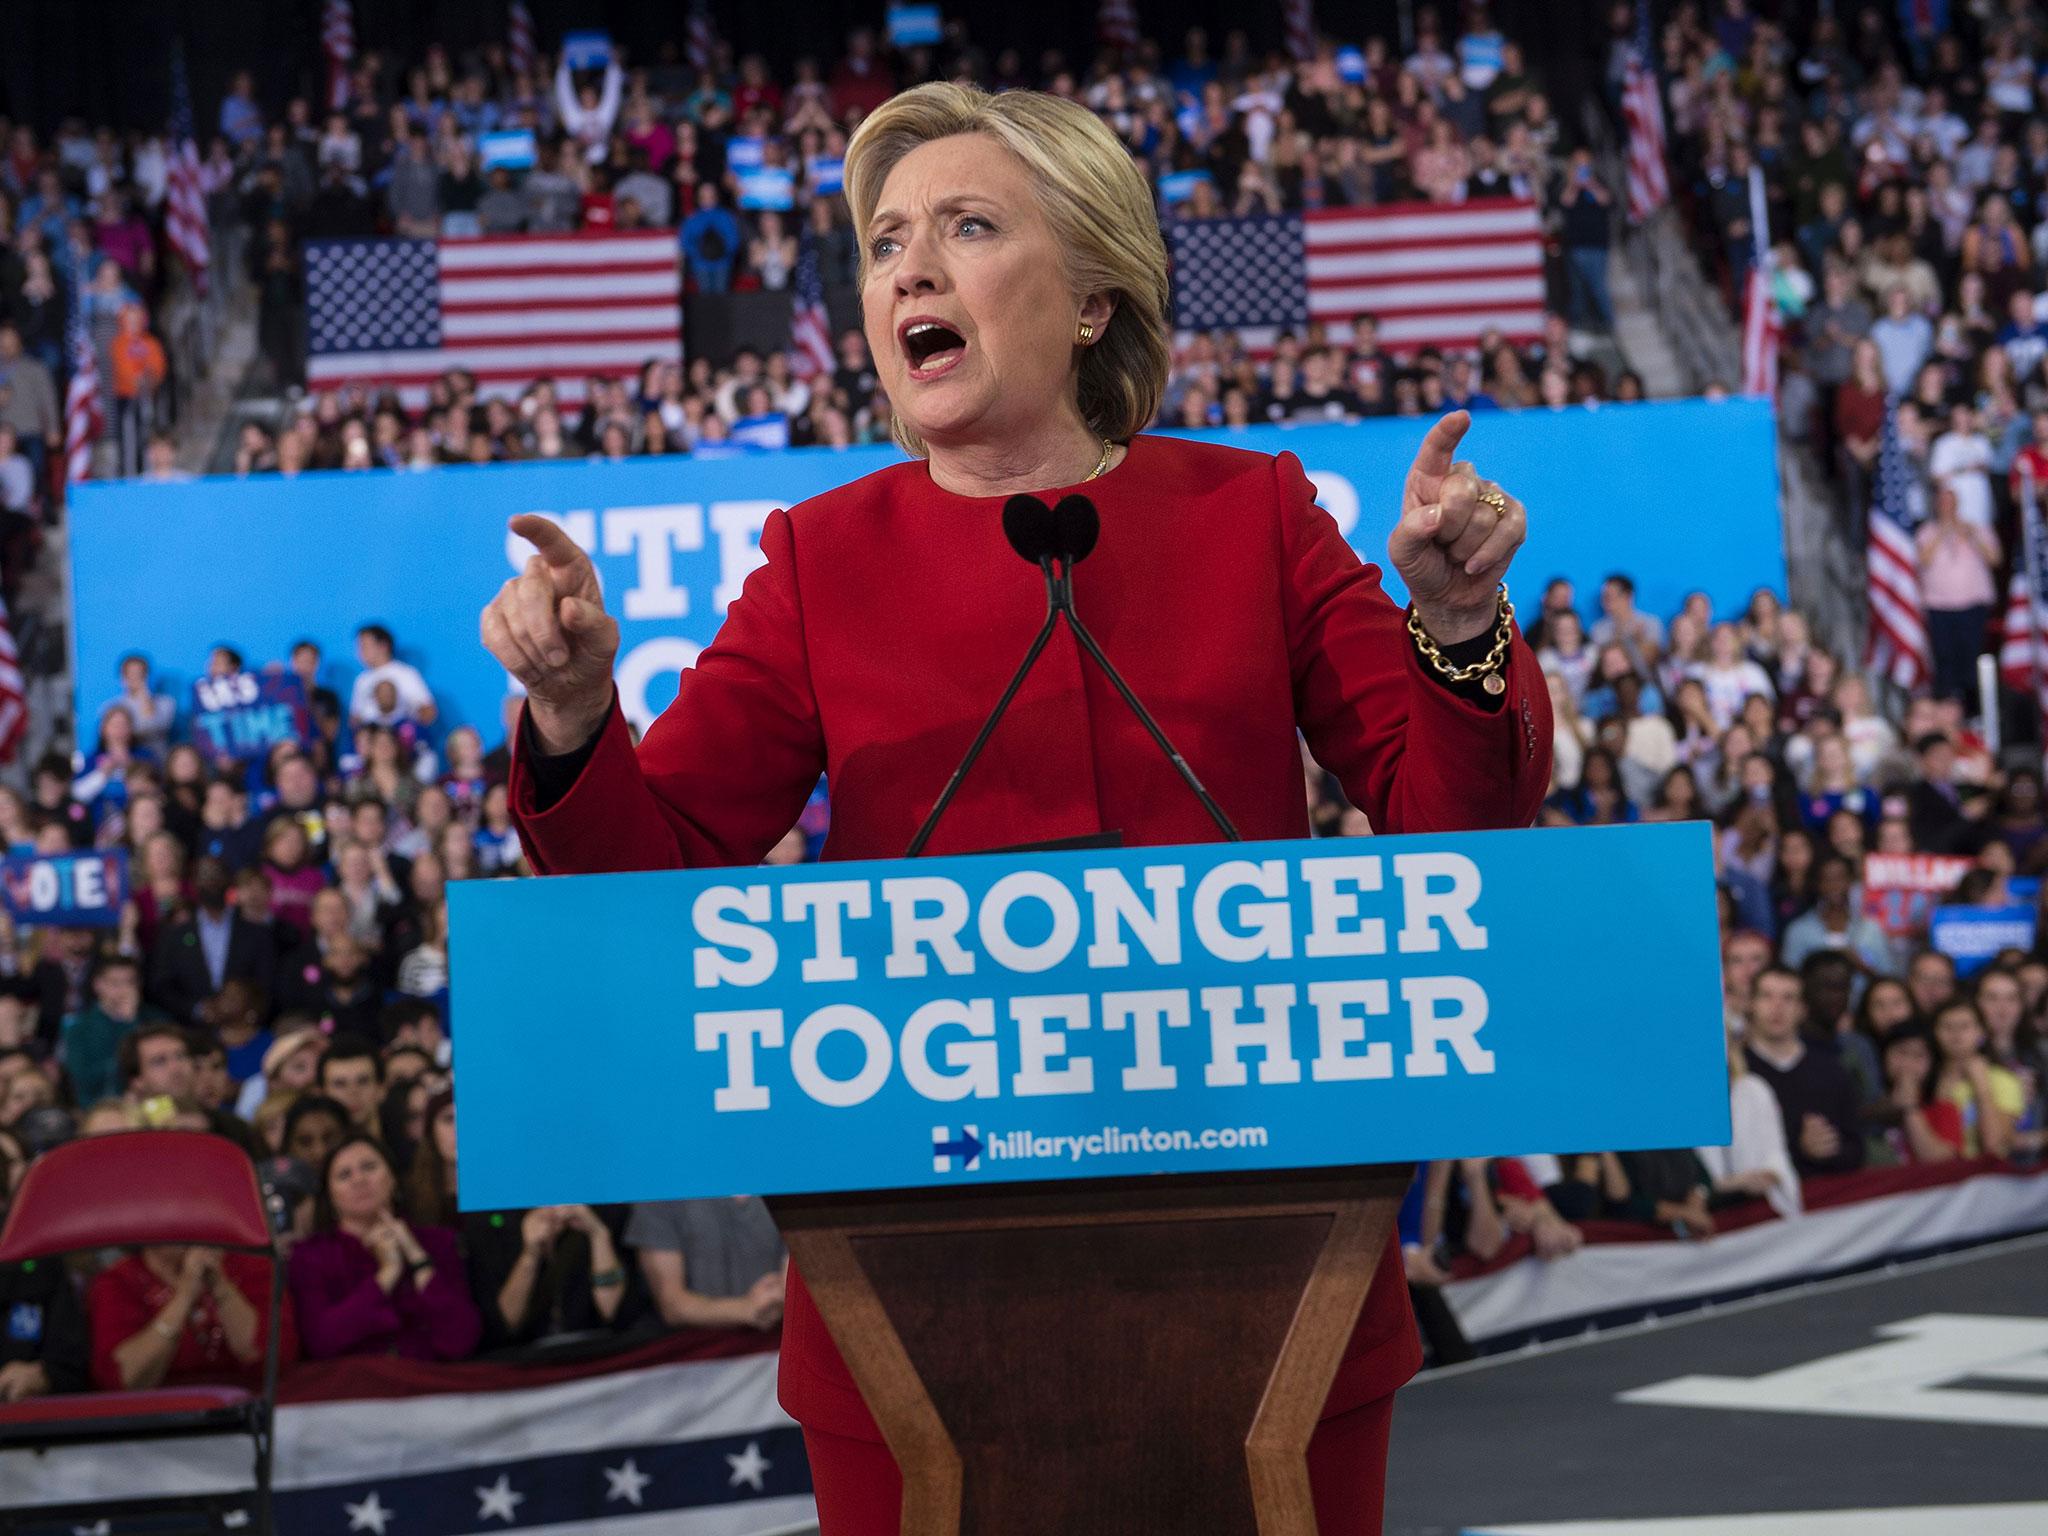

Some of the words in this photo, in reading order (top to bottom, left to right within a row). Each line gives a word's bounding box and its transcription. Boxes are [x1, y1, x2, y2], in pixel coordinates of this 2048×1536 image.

[692, 852, 1488, 988] STRONGER
[694, 976, 1496, 1111] TOGETHER
[988, 1126, 1268, 1162] hillaryclinton.com
